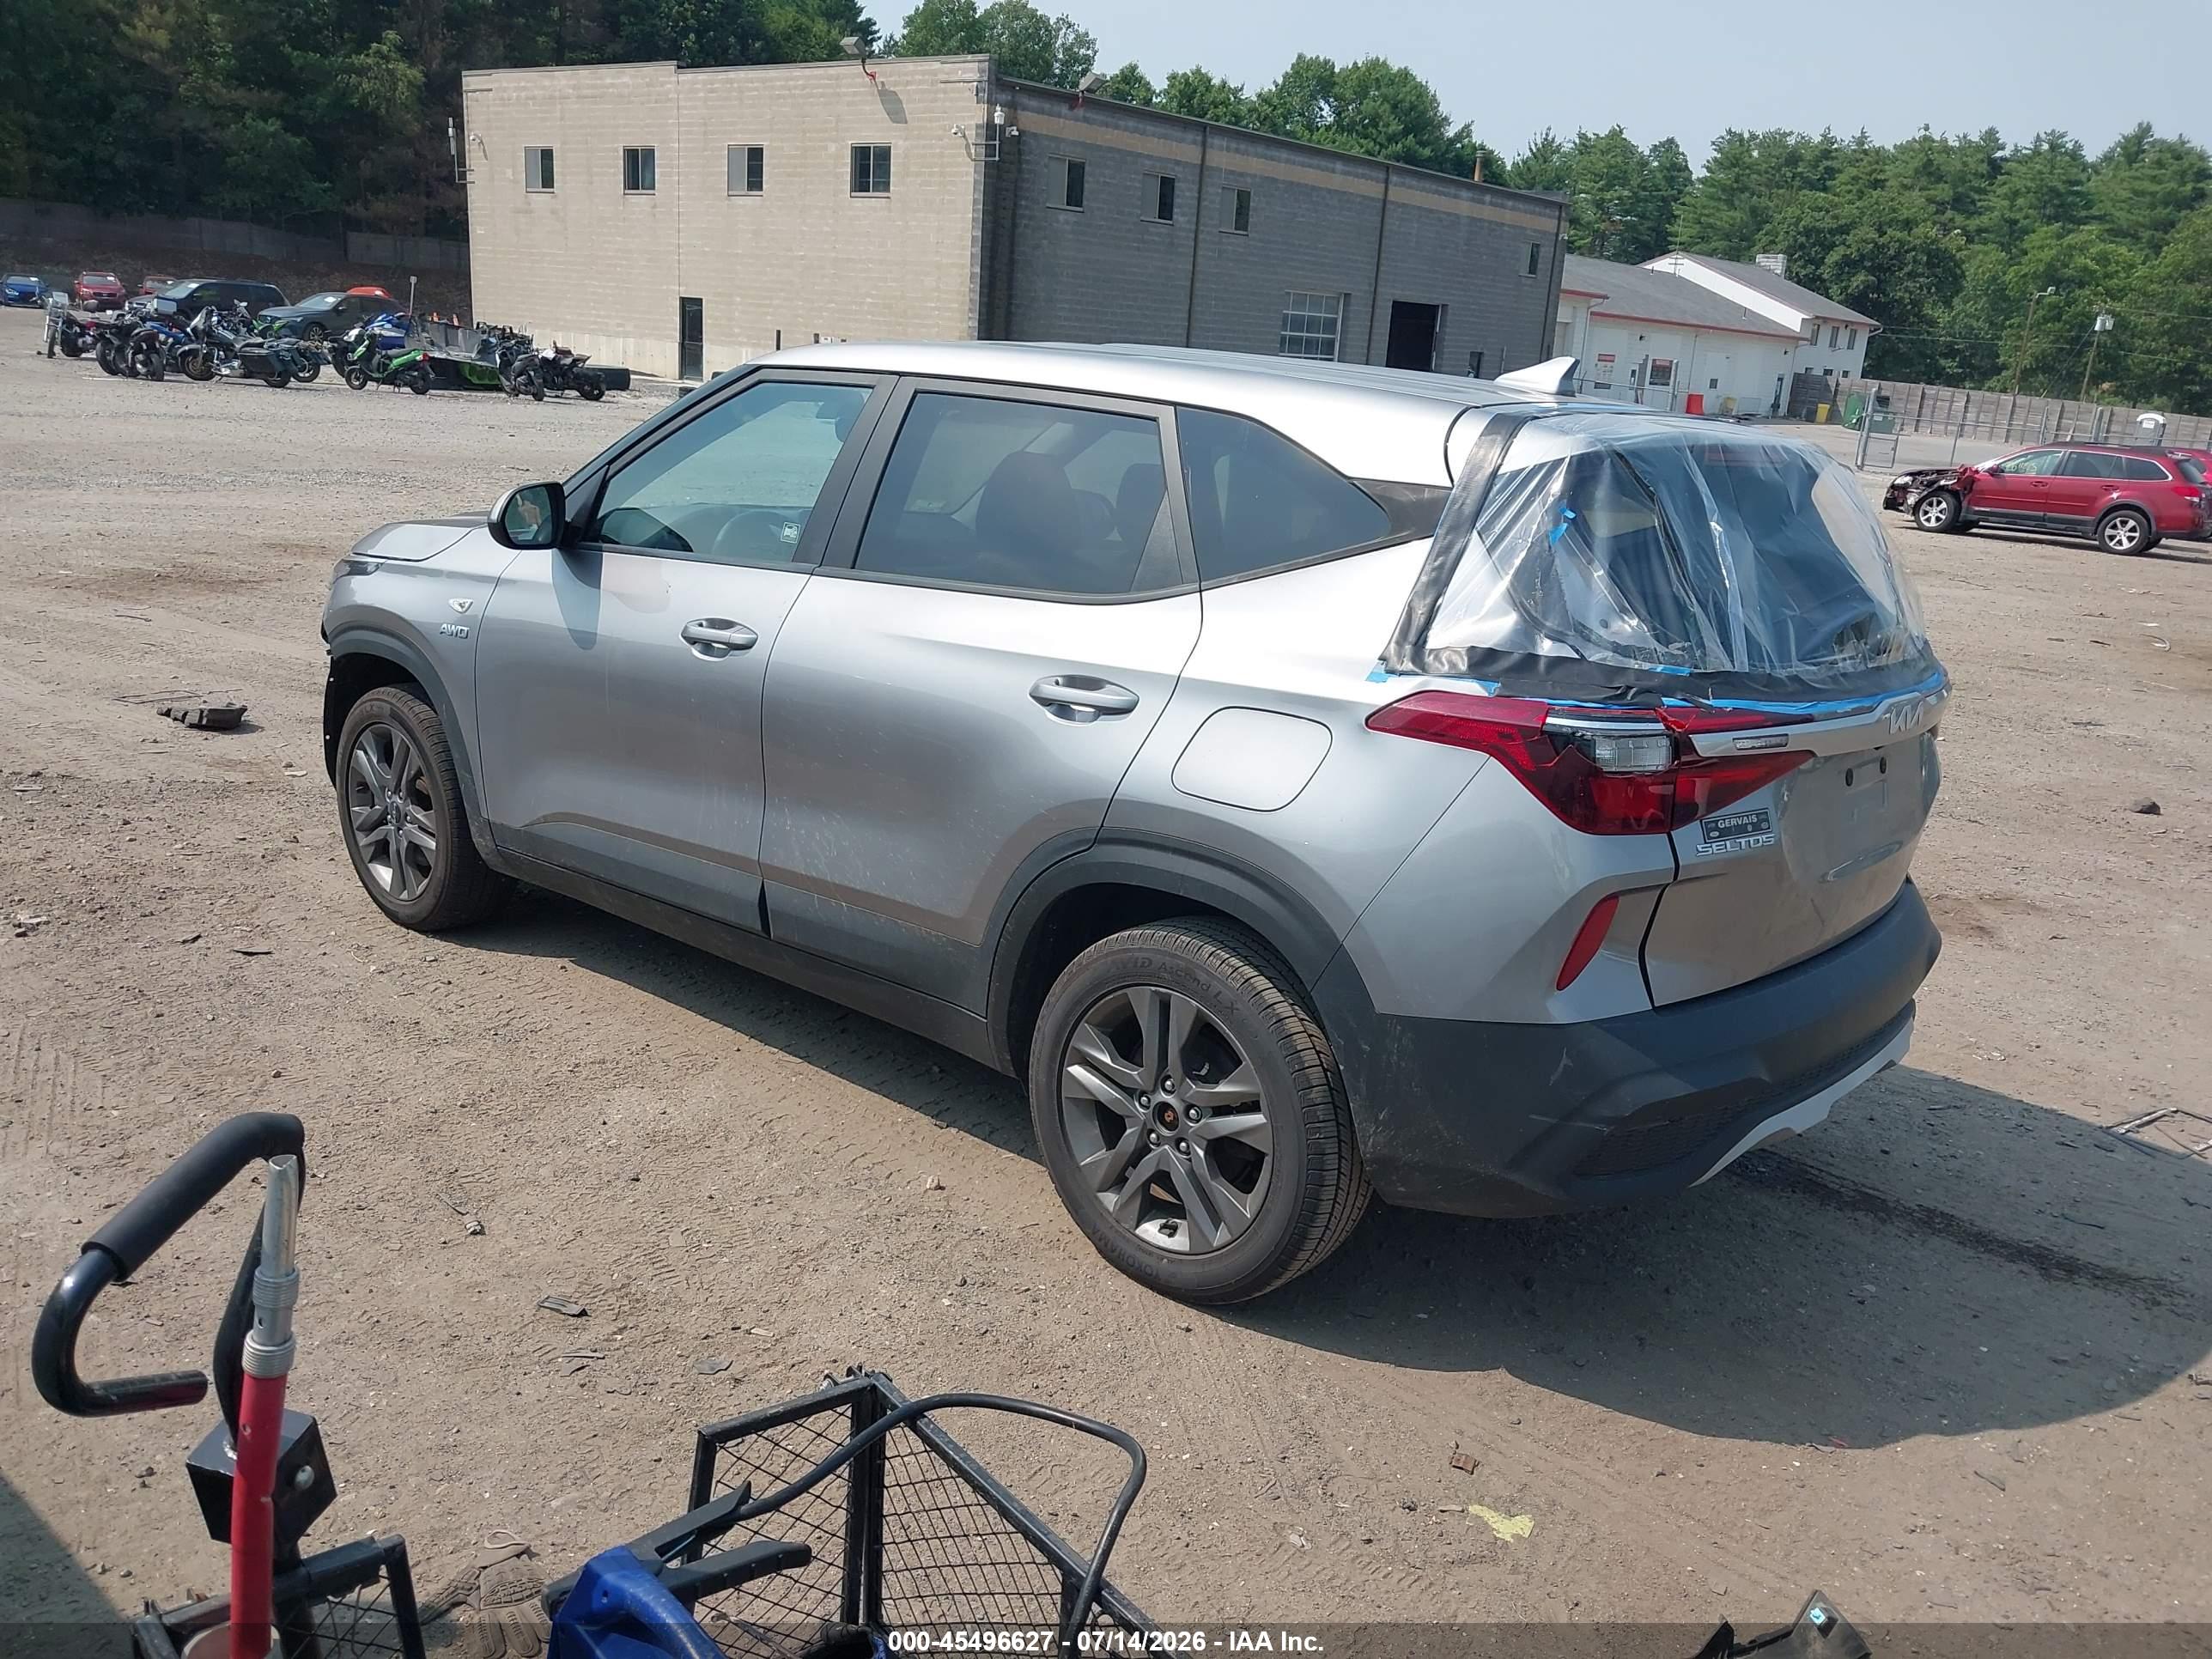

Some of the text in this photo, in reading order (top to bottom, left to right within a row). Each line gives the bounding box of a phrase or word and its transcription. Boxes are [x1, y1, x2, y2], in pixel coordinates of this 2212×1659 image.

[440, 623, 470, 639] AWD
[1717, 814, 1758, 829] GERVAIS
[1696, 833, 1775, 857] SELTOS
